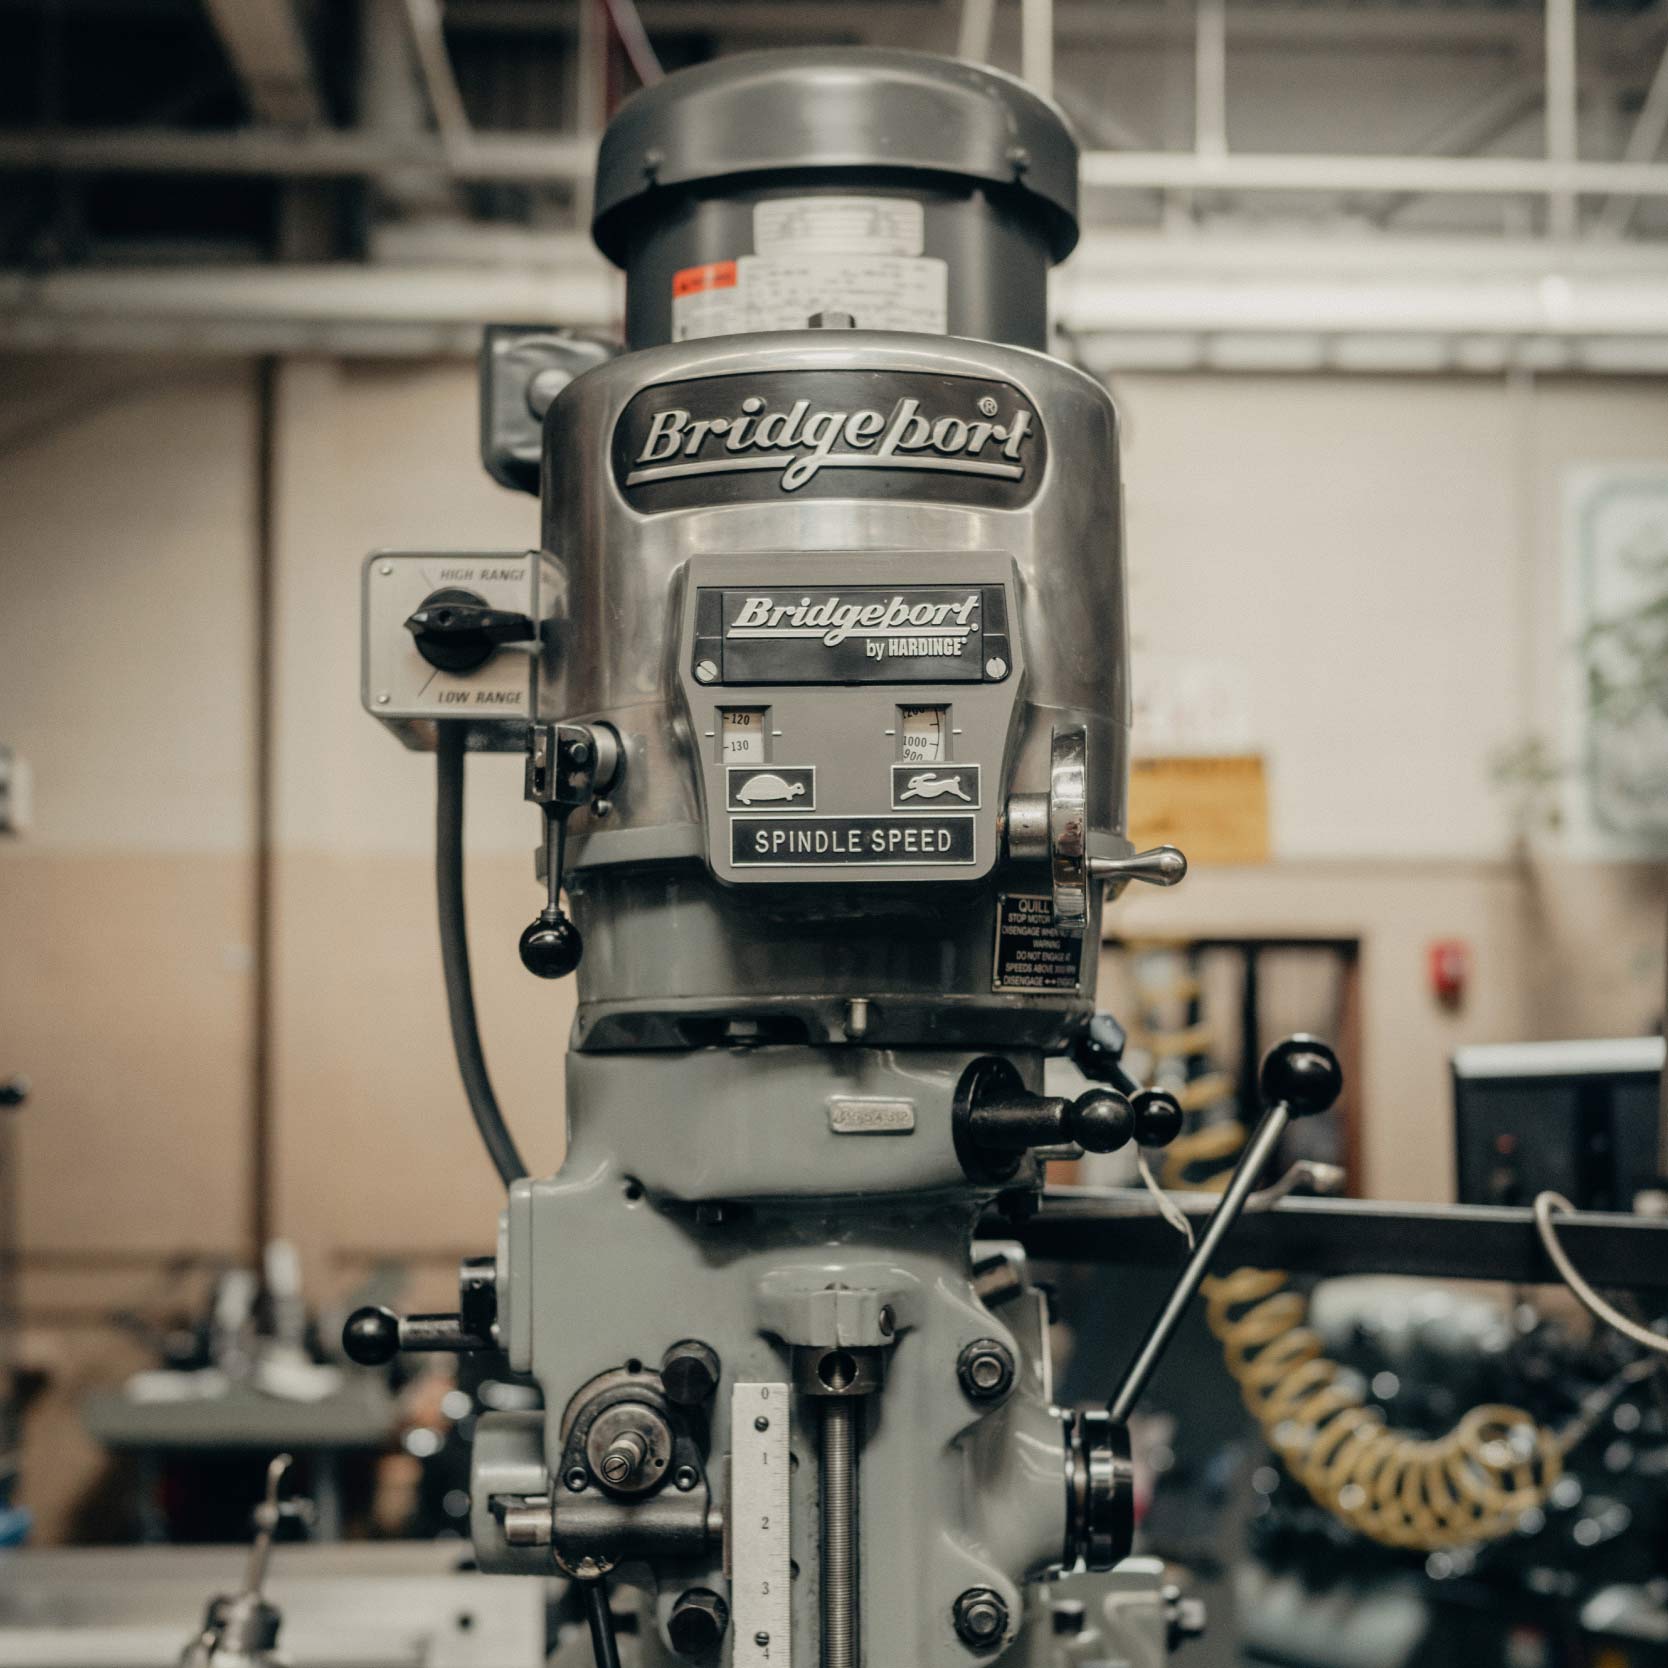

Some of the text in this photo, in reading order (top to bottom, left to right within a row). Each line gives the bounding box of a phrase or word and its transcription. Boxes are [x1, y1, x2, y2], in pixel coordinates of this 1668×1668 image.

[440, 569, 526, 581] HIGH RANGE
[866, 639, 885, 661] by
[438, 691, 523, 704] LOW RANGE
[731, 713, 750, 726] 120
[731, 740, 749, 752] 130
[903, 735, 927, 748] 1000
[755, 829, 952, 854] SPINDLE SPEED
[1018, 899, 1050, 913] QUILL
[1008, 913, 1051, 924] STOP MOTOR
[1002, 925, 1040, 936] DISENGAGE
[1033, 940, 1061, 949] WARNING
[1016, 951, 1027, 960] DO
[1028, 951, 1041, 961] NOT
[1005, 962, 1032, 973] SPEEDS
[1004, 976, 1043, 987] DISENGAGE
[761, 1387, 770, 1400] 0
[762, 1452, 769, 1465] 1
[761, 1516, 770, 1530] 2
[761, 1582, 770, 1596] 3
[761, 1647, 770, 1660] 4
